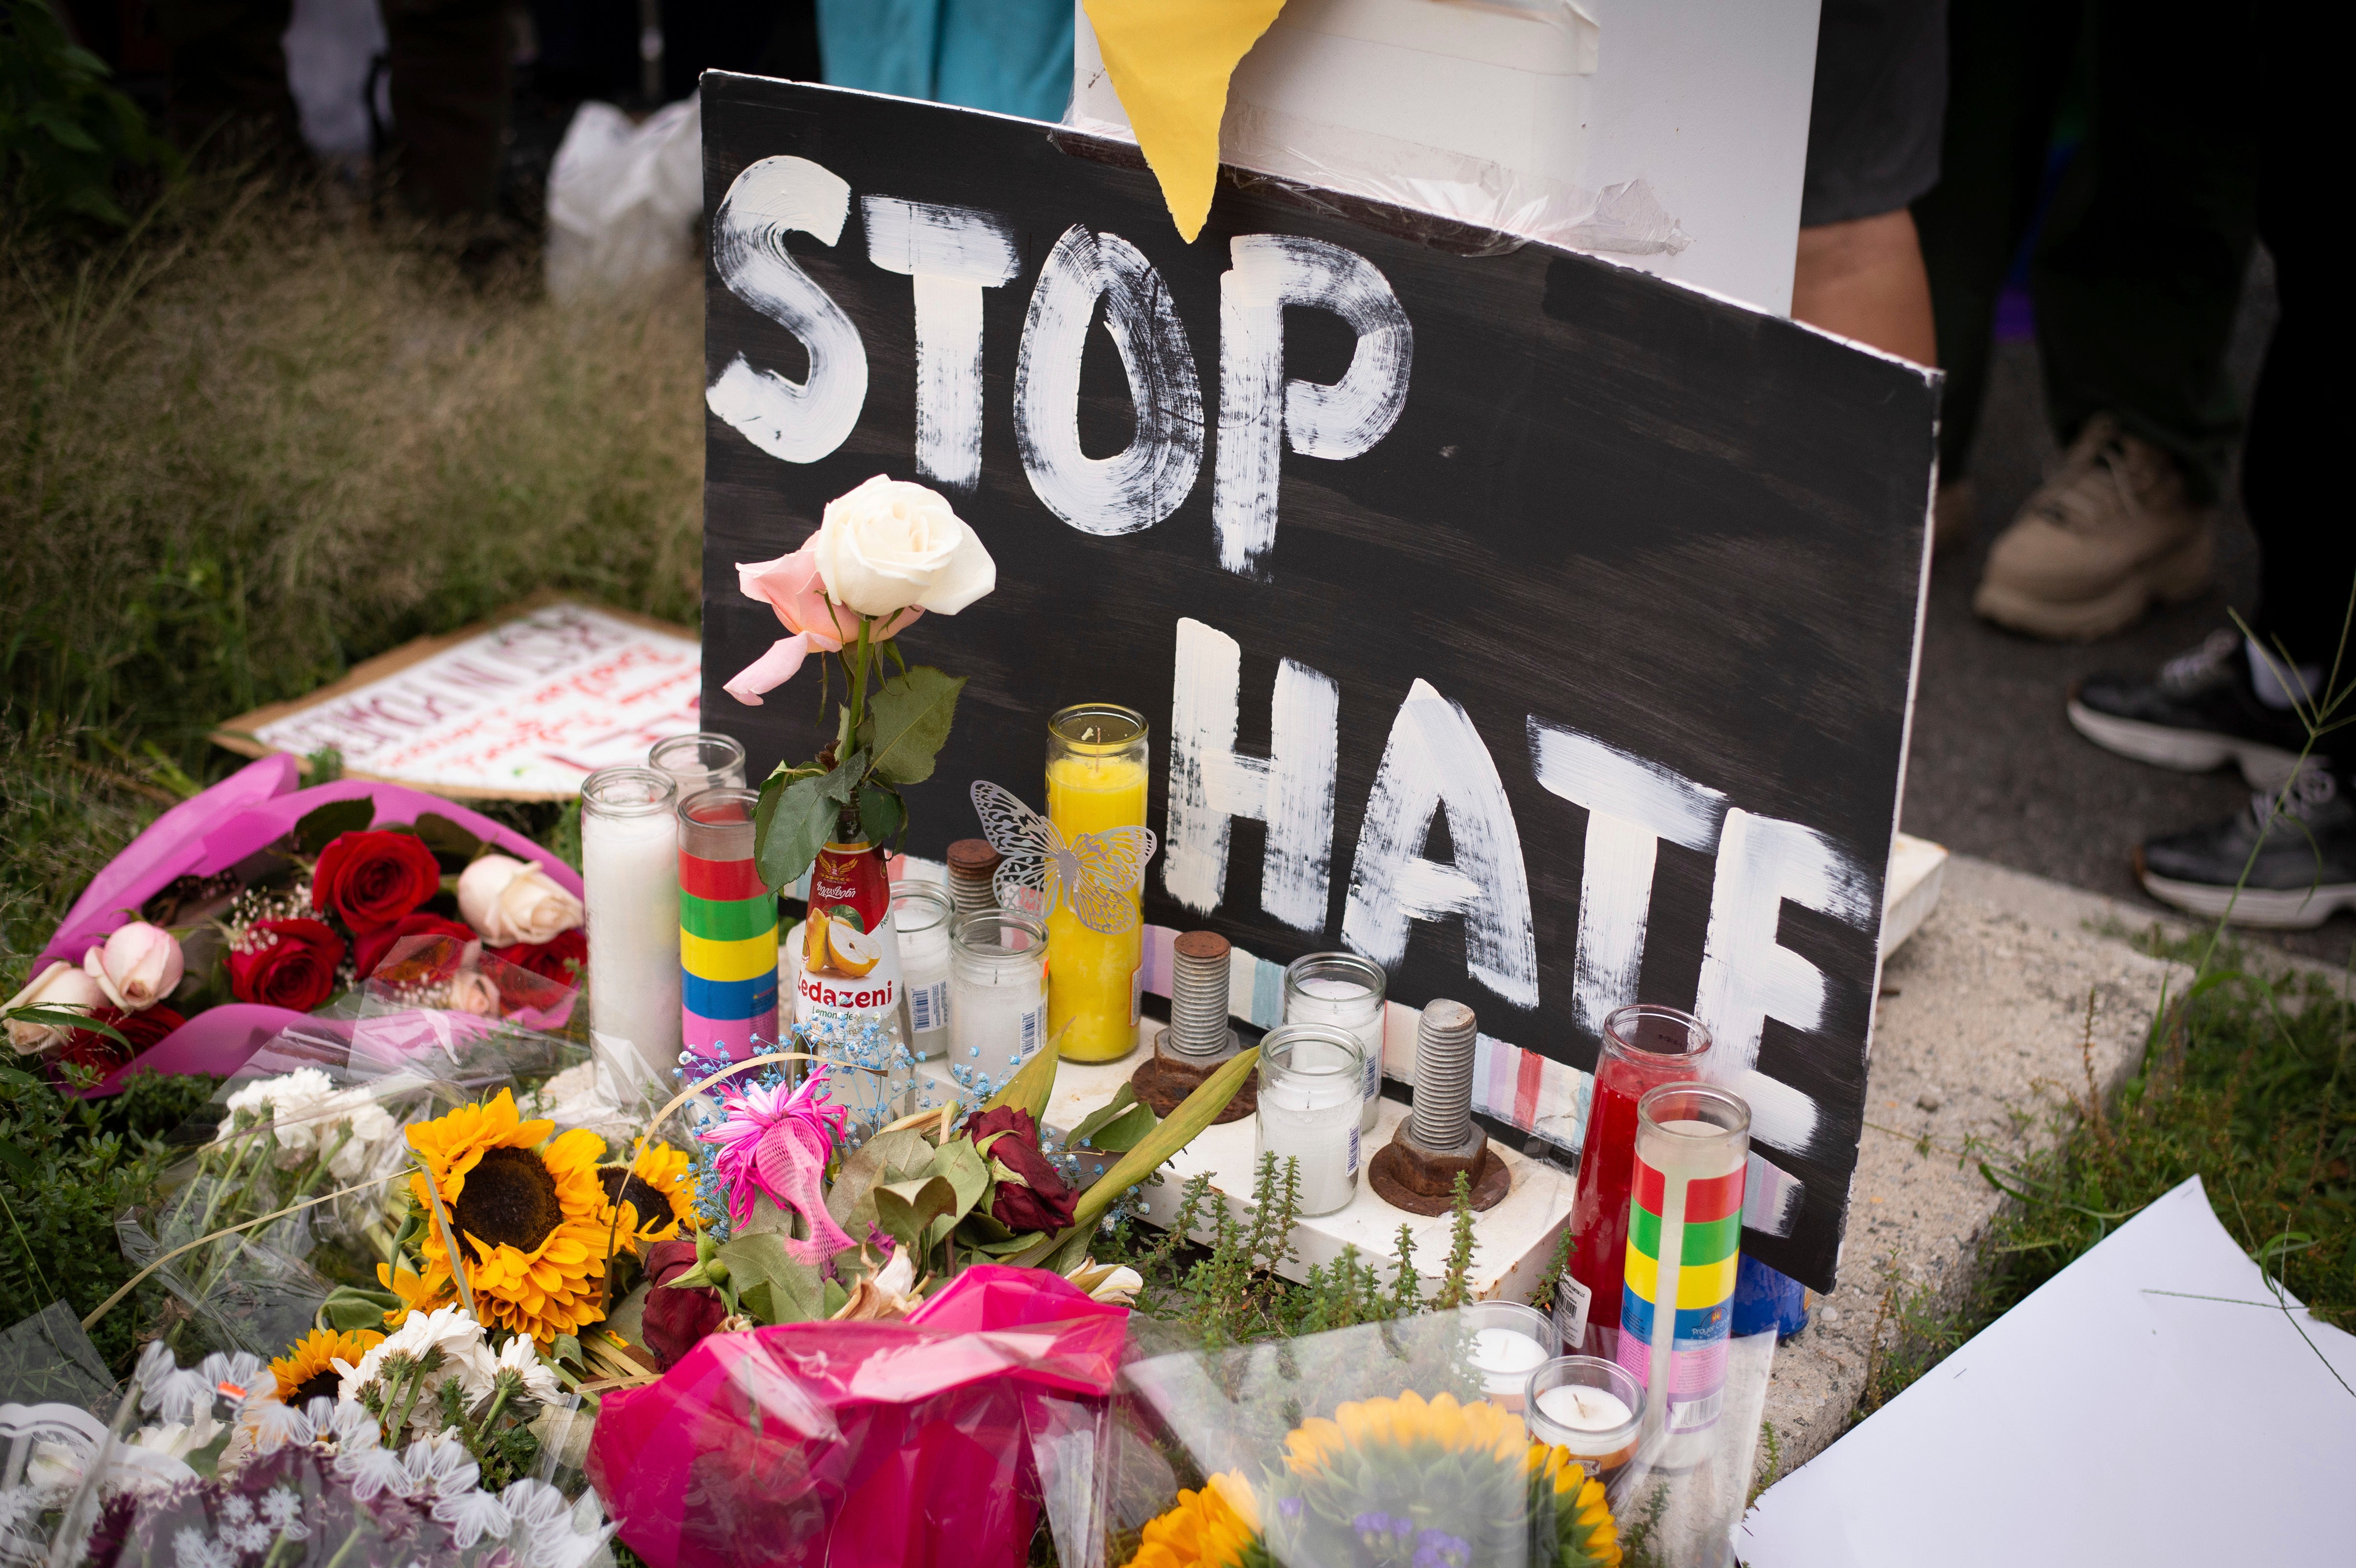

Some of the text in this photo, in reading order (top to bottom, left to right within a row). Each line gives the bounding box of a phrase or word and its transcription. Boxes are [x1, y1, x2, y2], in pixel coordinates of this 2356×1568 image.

[706, 154, 1414, 579] STOP
[1163, 617, 1882, 1155] HATE
[880, 912, 890, 929] Pear
[812, 1006, 854, 1021] Lemonde
[1692, 1325, 1715, 1335] Prayer
